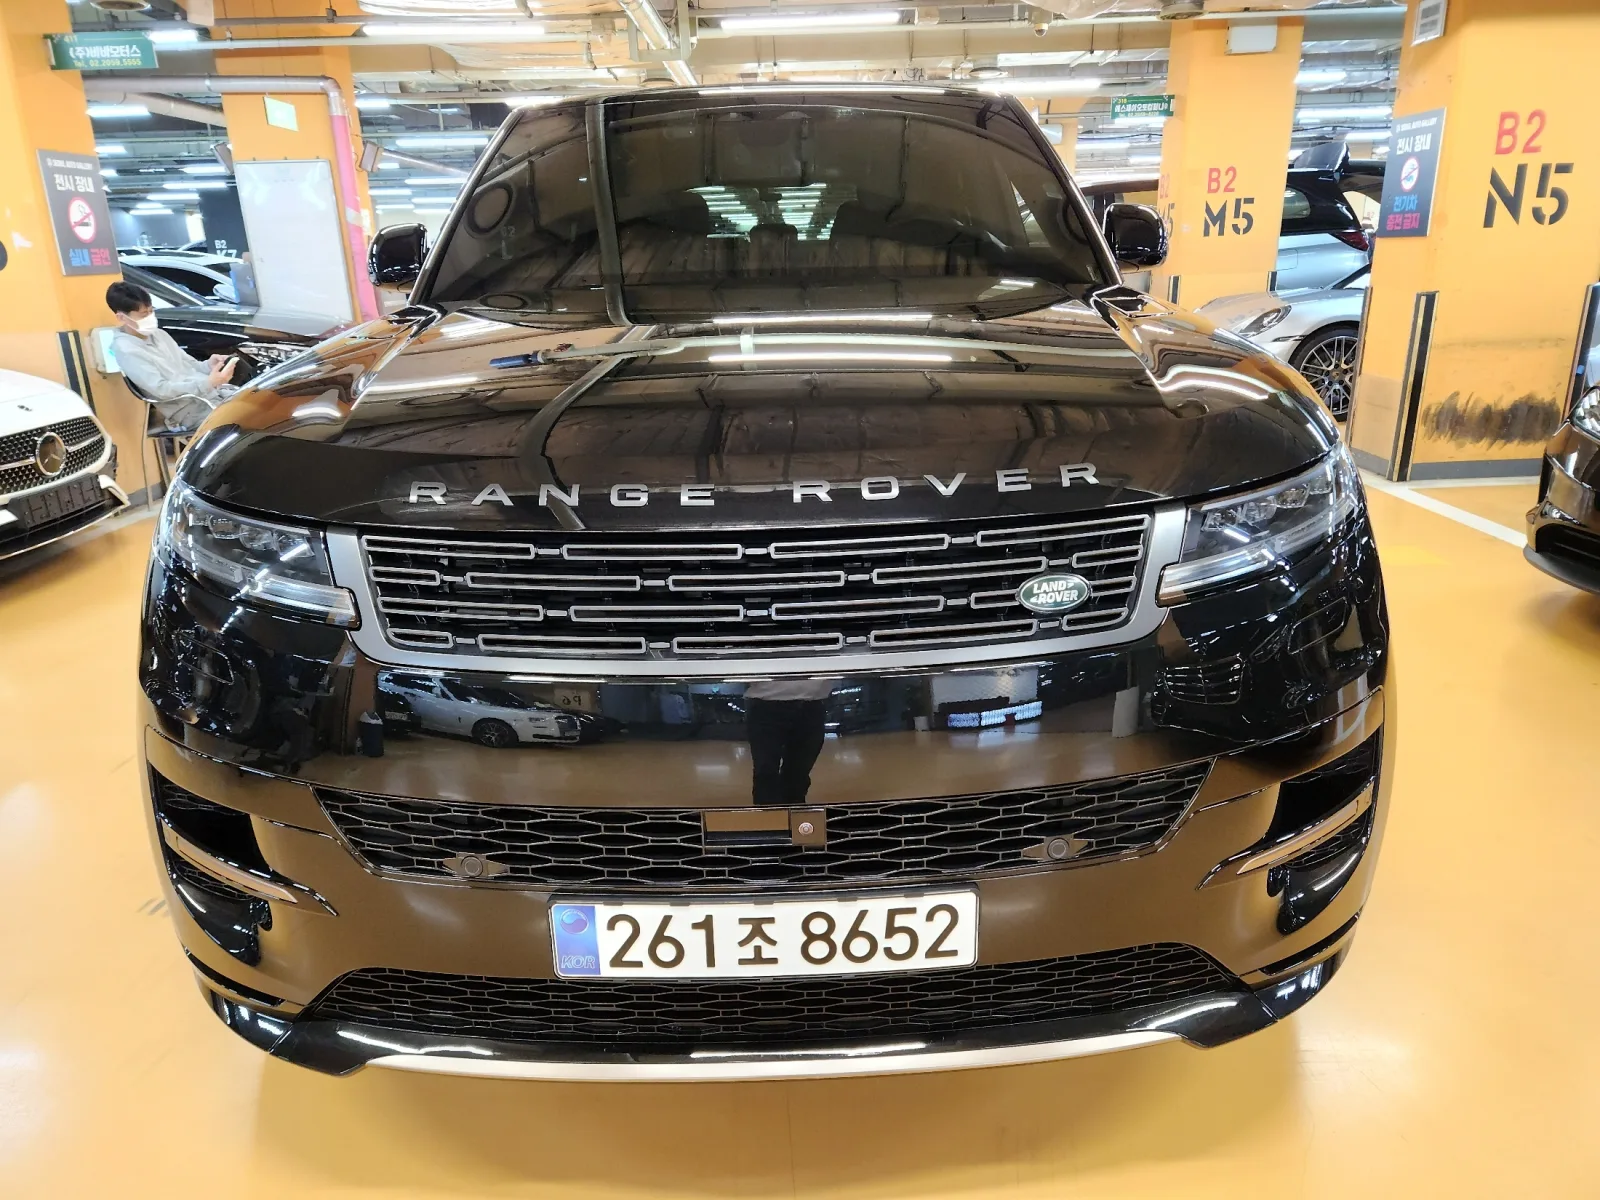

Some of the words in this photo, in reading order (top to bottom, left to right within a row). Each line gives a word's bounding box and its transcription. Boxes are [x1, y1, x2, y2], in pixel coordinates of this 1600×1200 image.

[1495, 109, 1547, 155] B2
[1396, 136, 1414, 155] 전시
[1413, 133, 1432, 152] 장내
[53, 173, 75, 191] 전시
[74, 175, 95, 193] 장내
[1207, 166, 1237, 194] B2
[1393, 194, 1418, 212] 전기차
[1483, 163, 1574, 228] N5
[1203, 198, 1255, 238] M5
[214, 239, 227, 249] B2
[408, 481, 715, 507] RANGE
[793, 462, 1100, 503] ROVER
[1033, 580, 1067, 594] LAND
[1037, 590, 1079, 604] ROVER
[606, 913, 779, 969] 261조
[800, 903, 960, 965] 8652
[561, 955, 596, 969] KOR
